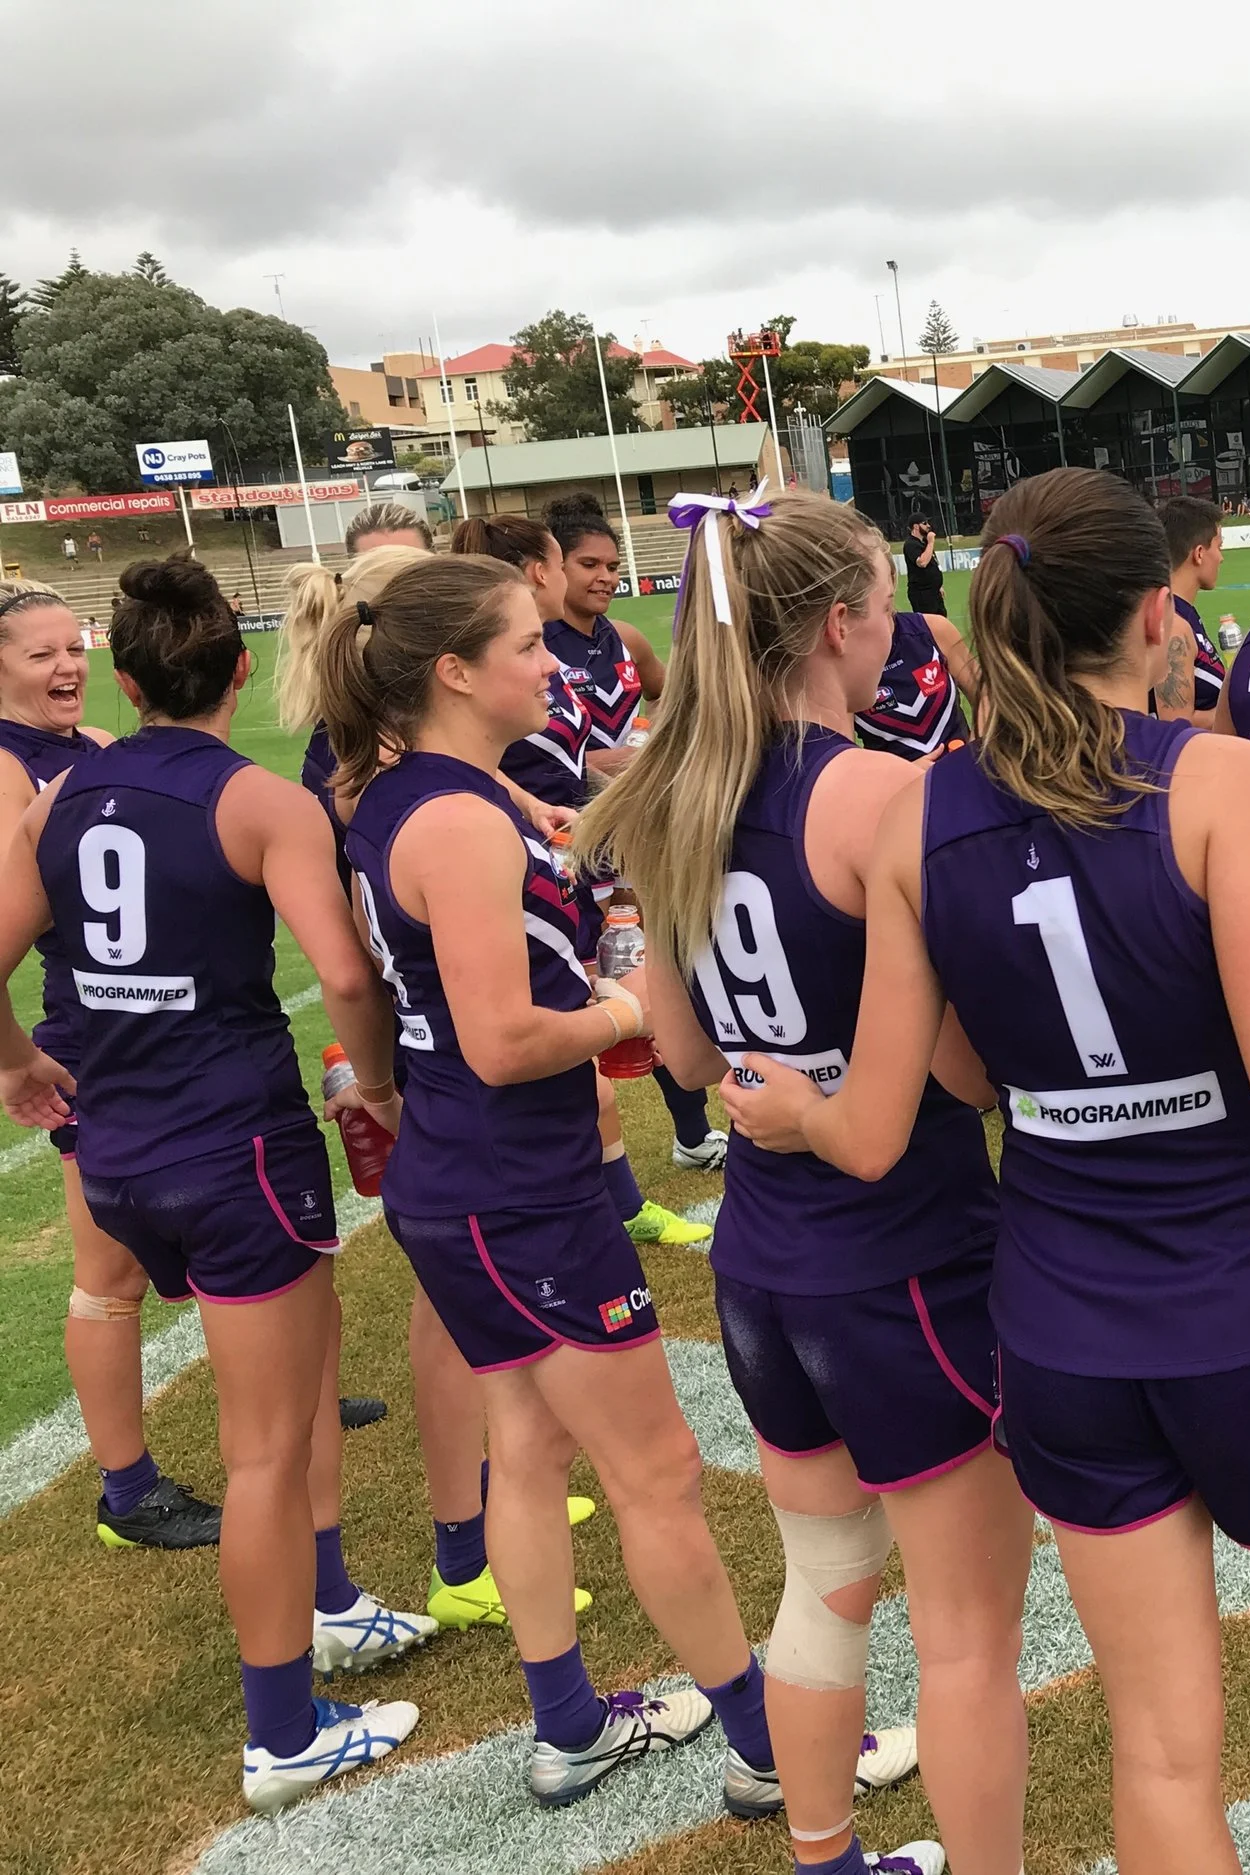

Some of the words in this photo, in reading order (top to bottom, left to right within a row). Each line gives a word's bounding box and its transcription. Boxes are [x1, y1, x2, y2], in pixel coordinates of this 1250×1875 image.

[144, 453, 163, 465] NJ
[167, 454, 187, 463] Cray
[188, 452, 206, 460] Pots
[199, 487, 294, 505] standout
[5, 503, 40, 516] FLN
[49, 499, 126, 516] commercial
[128, 495, 171, 512] repairs
[655, 575, 682, 590] nab
[237, 619, 284, 631] niversit
[567, 670, 590, 680] AFL
[77, 823, 147, 967] 9
[693, 870, 808, 1046] 19
[1011, 875, 1129, 1079] 1
[82, 983, 188, 1002] PROGRAMMED
[1040, 1089, 1212, 1125] PROGRAMMED
[634, 1226, 660, 1235] asics
[629, 1286, 652, 1311] Cho
